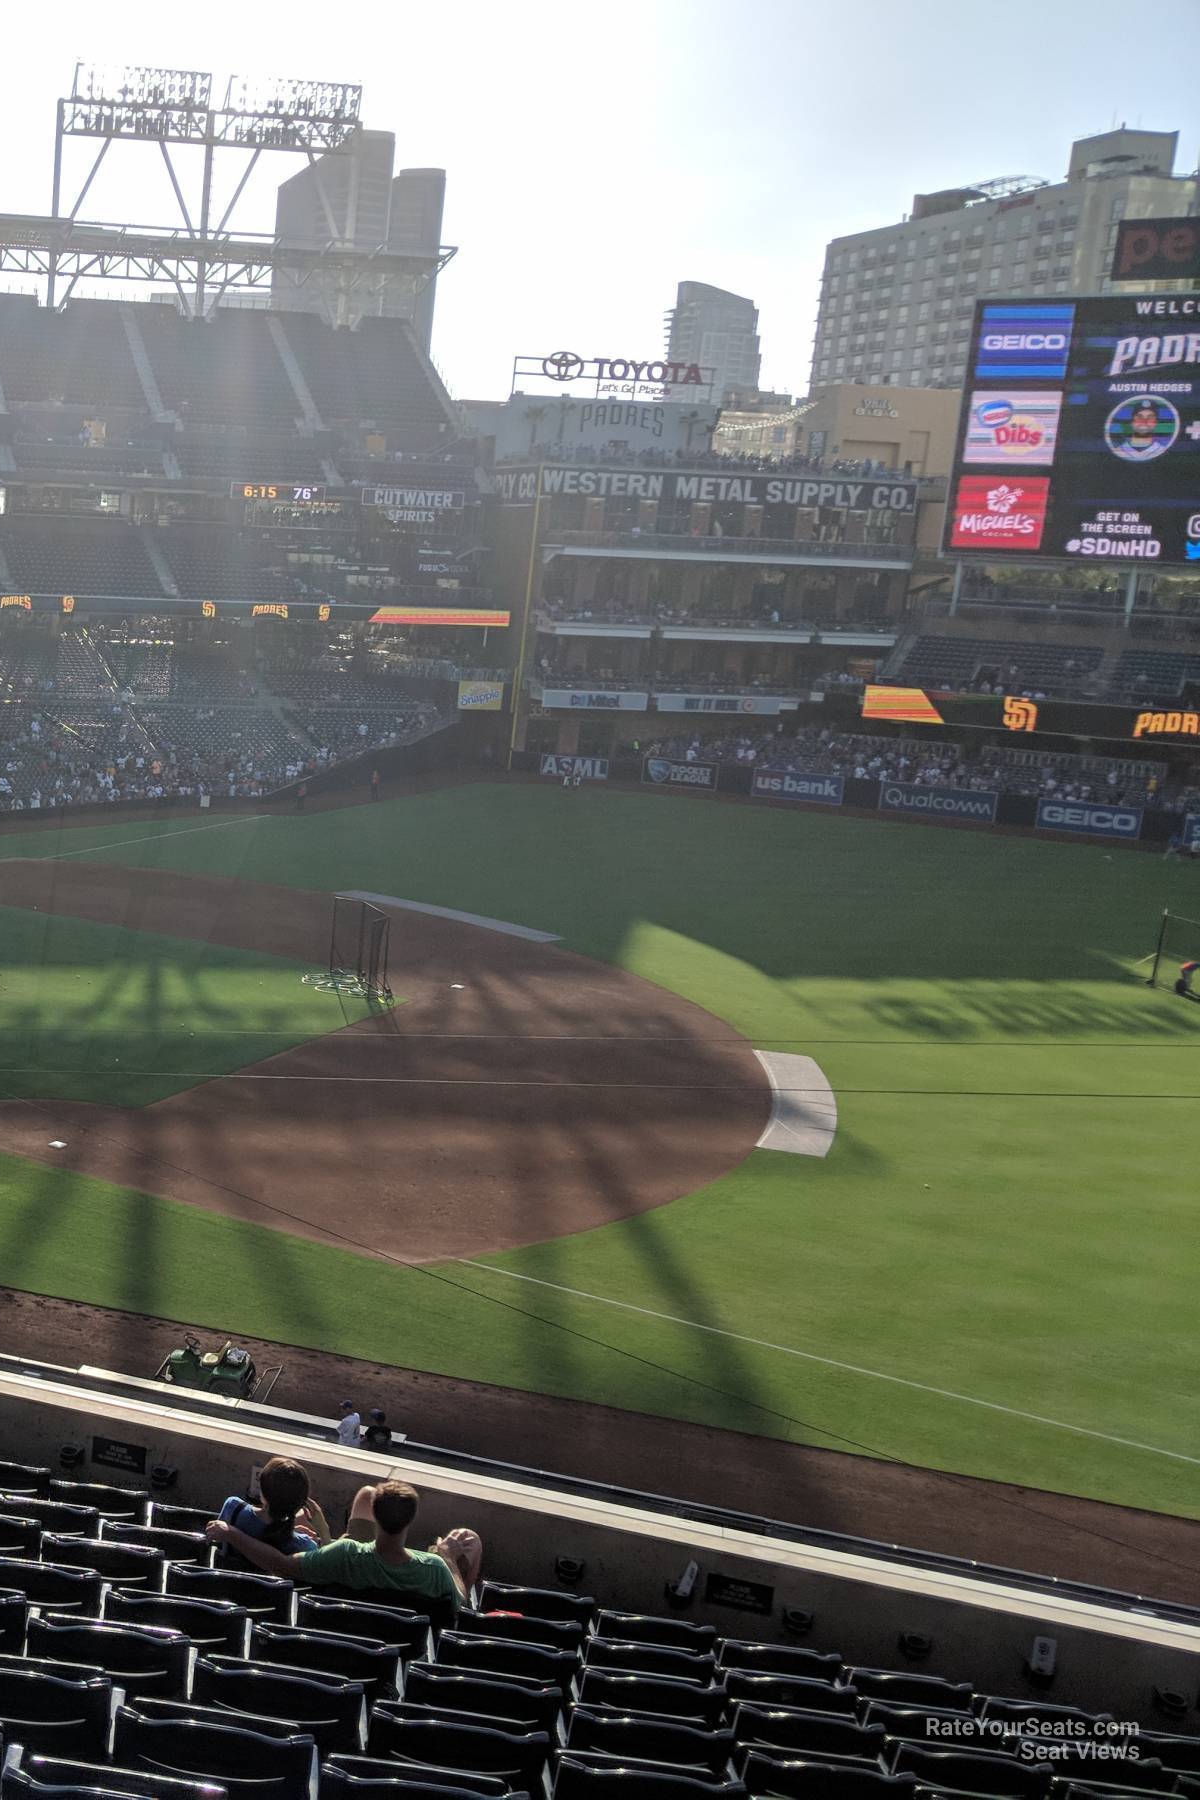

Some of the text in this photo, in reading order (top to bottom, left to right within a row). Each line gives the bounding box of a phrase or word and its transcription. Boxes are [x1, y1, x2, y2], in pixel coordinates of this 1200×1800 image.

[982, 334, 1066, 350] GEICO
[594, 357, 704, 386] TOYOTA
[621, 383, 635, 394] Go
[1108, 383, 1192, 393] AUSTIN HEDGES
[580, 404, 666, 438] PADRES
[994, 423, 1042, 447] Dibs
[243, 486, 277, 498] 6:15
[374, 489, 453, 507] CUTWATER
[543, 469, 914, 512] WESTERN METAL SUPPLY CO.
[388, 510, 435, 522] SPIRITS
[1097, 512, 1139, 523] GET ON
[1081, 523, 1152, 535] THE SCREEN
[1, 594, 31, 610] PADRES
[252, 604, 289, 618] PADRES
[460, 688, 500, 706] Snapple
[1133, 712, 1200, 738] PADR
[542, 755, 607, 779] ASML
[670, 772, 712, 786] LEAGUE
[884, 788, 993, 816] Qualcomm
[1042, 805, 1138, 831] GEICO
